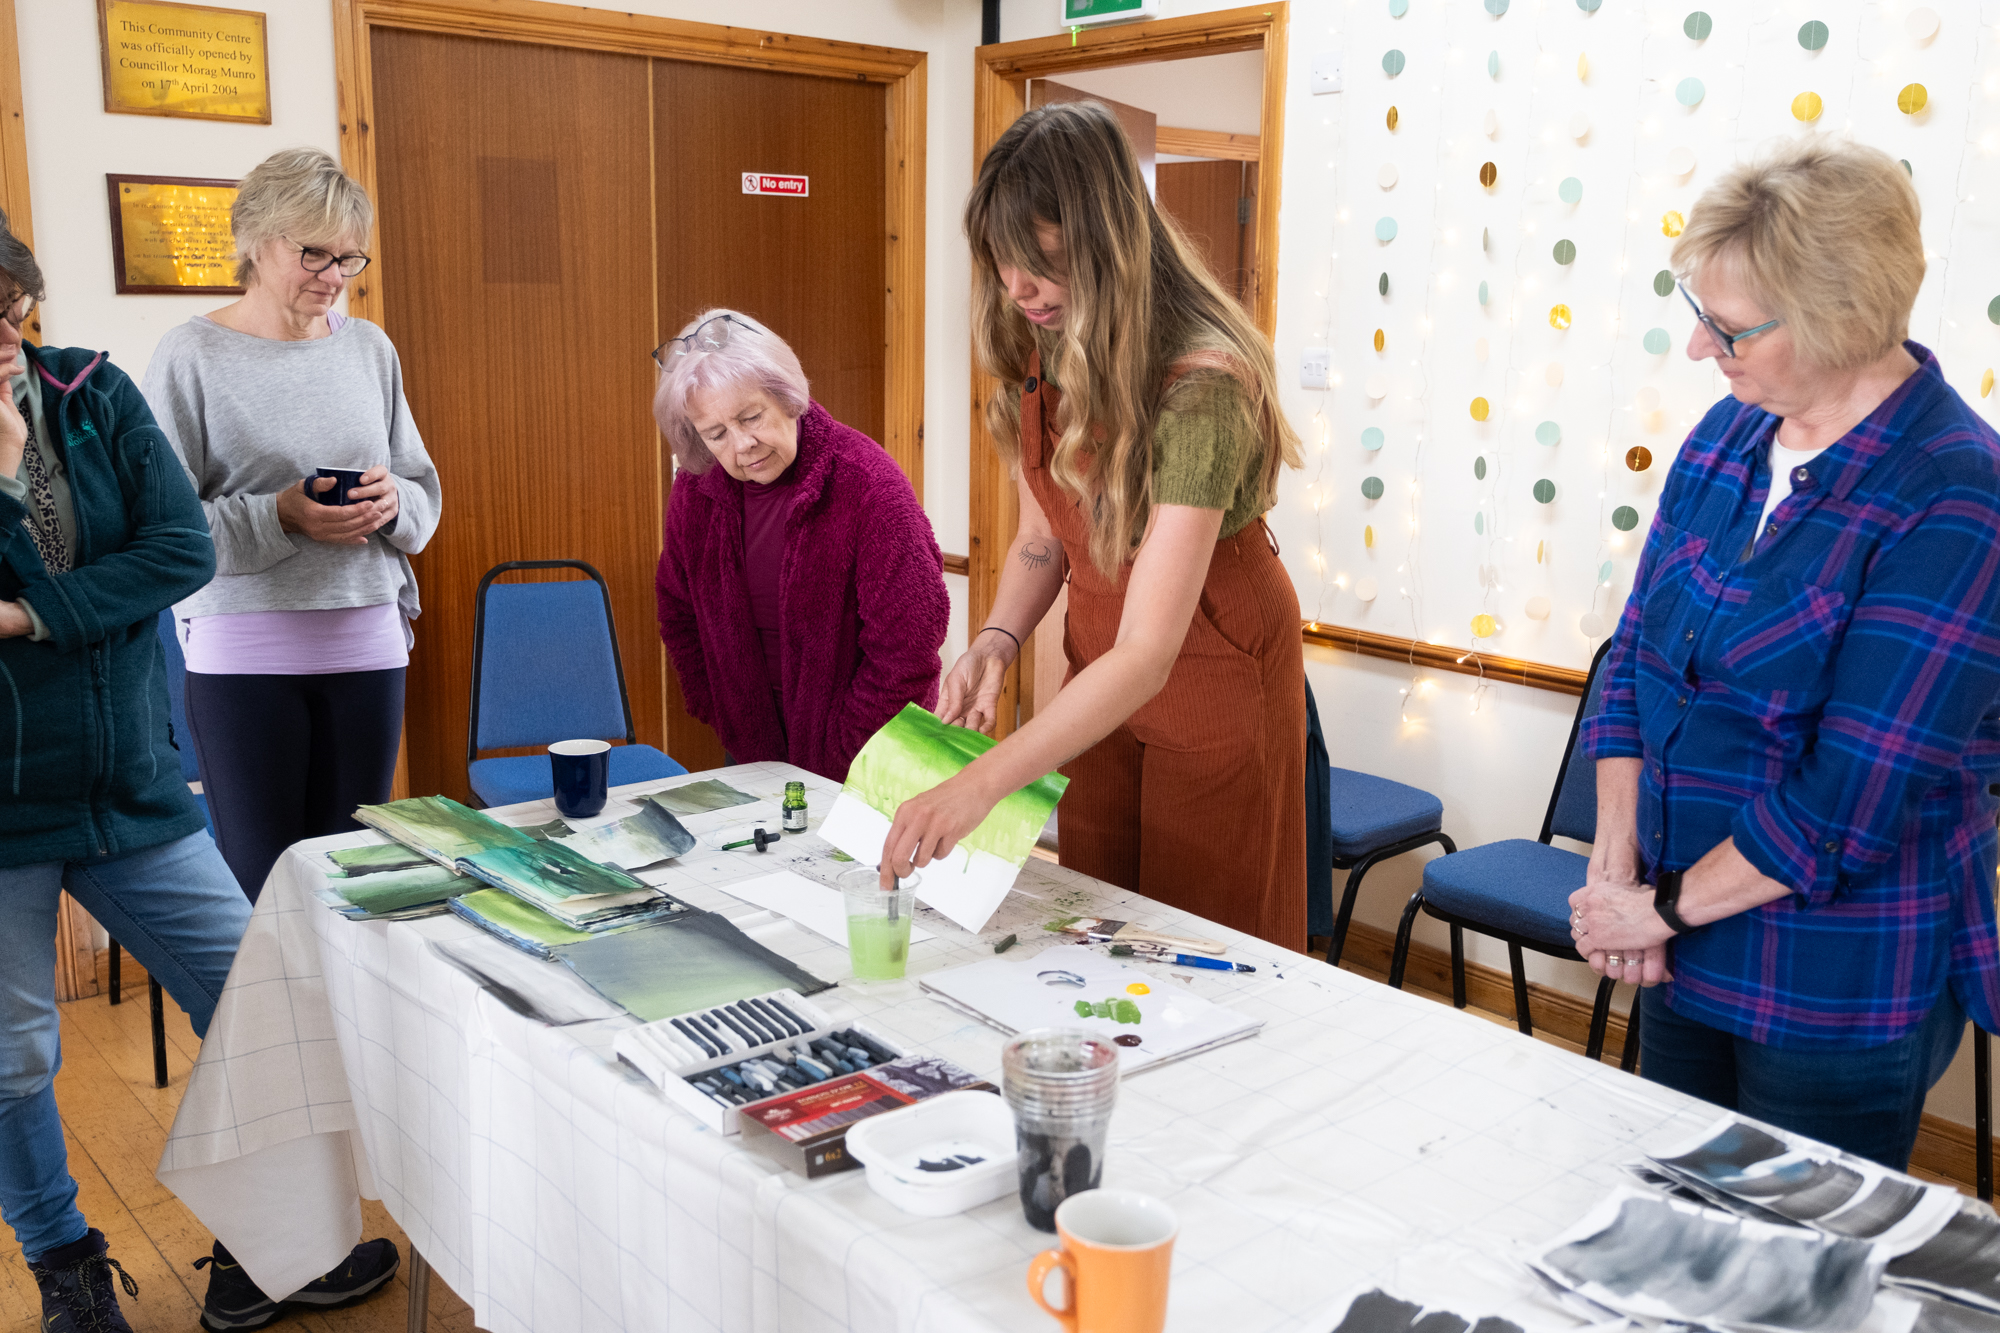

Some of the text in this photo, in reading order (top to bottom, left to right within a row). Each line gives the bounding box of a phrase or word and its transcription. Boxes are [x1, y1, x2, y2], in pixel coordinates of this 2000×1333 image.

[120, 20, 251, 44] This Community Centre
[120, 41, 252, 64] was officially opened by
[120, 57, 256, 80] Councillor Morag Munro
[141, 78, 238, 96] on 17th April 2004
[762, 178, 803, 192] No entry
